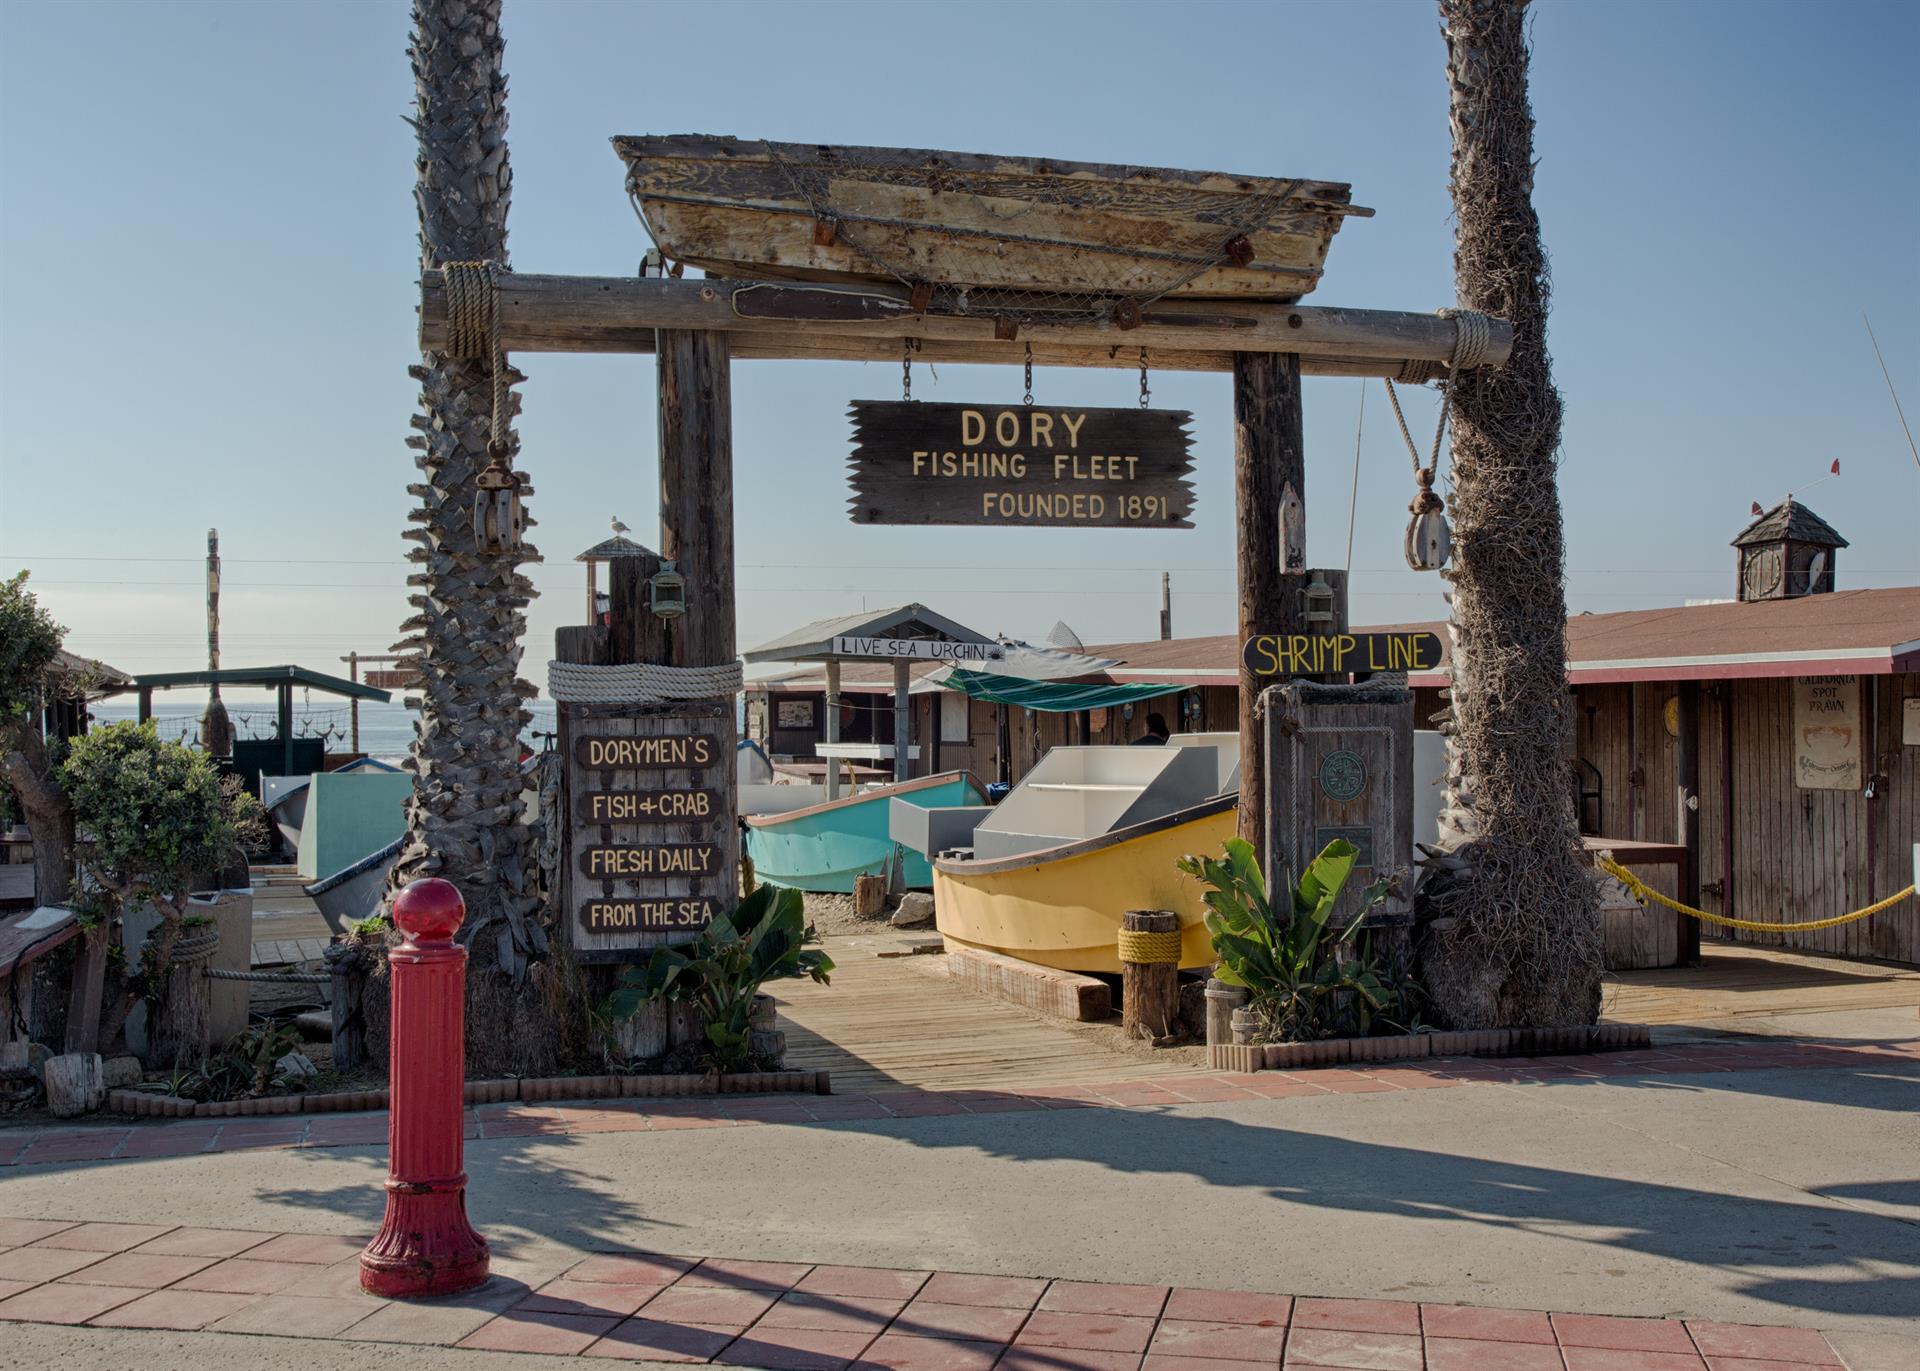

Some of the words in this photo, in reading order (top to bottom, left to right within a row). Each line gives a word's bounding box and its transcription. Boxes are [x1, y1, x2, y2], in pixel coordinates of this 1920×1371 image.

[962, 410, 1086, 447] DORY
[913, 451, 1026, 478] FISHING
[1054, 455, 1139, 480] FLEET
[983, 493, 1105, 518] FOUNDED
[1117, 496, 1168, 520] 1891
[841, 637, 882, 655] LIVE
[888, 640, 917, 656] SEA
[931, 643, 985, 660] URCHIN
[1255, 635, 1356, 674] SHRIMP
[1368, 634, 1430, 670] LINE
[1808, 699, 1845, 713] PRAWN
[1812, 687, 1837, 698] SPOT
[590, 737, 709, 765] DORYMEN'S
[593, 795, 636, 819] FISH
[659, 792, 710, 817] CRAB
[591, 850, 653, 874] FRESH
[659, 848, 711, 872] DAILY
[591, 904, 637, 927] FROM
[641, 902, 674, 926] THE
[677, 901, 713, 926] SEA
